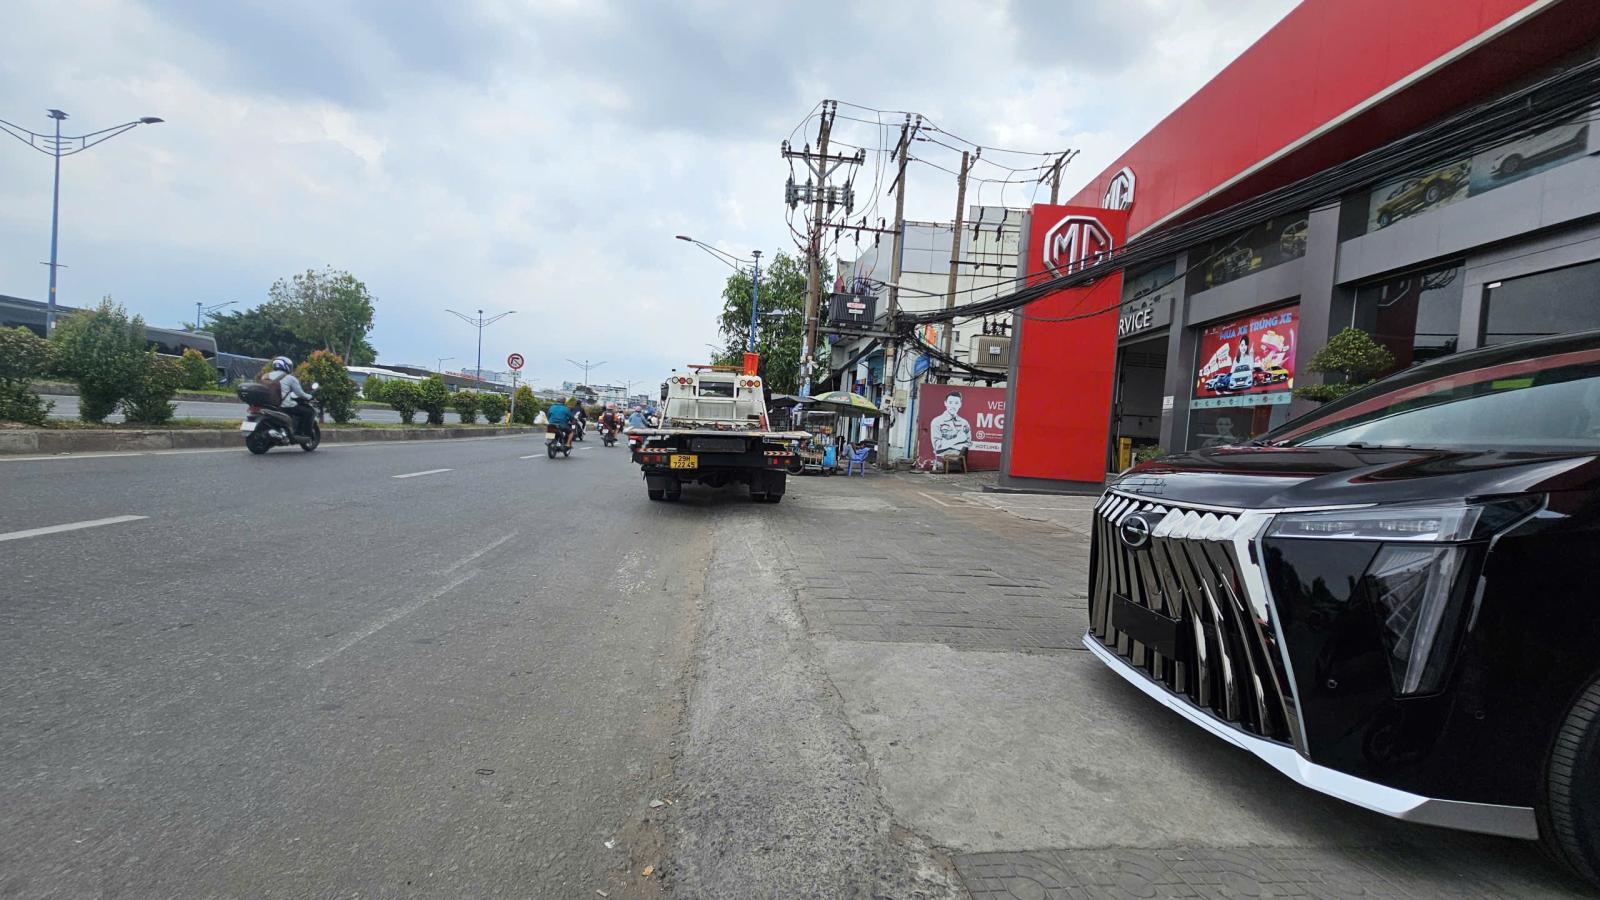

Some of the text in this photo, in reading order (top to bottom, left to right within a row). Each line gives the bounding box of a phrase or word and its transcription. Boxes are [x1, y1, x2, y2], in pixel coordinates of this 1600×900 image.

[1053, 223, 1106, 275] MG
[1118, 308, 1151, 336] RVICE
[1238, 325, 1248, 336] XE
[1279, 313, 1292, 324] XE
